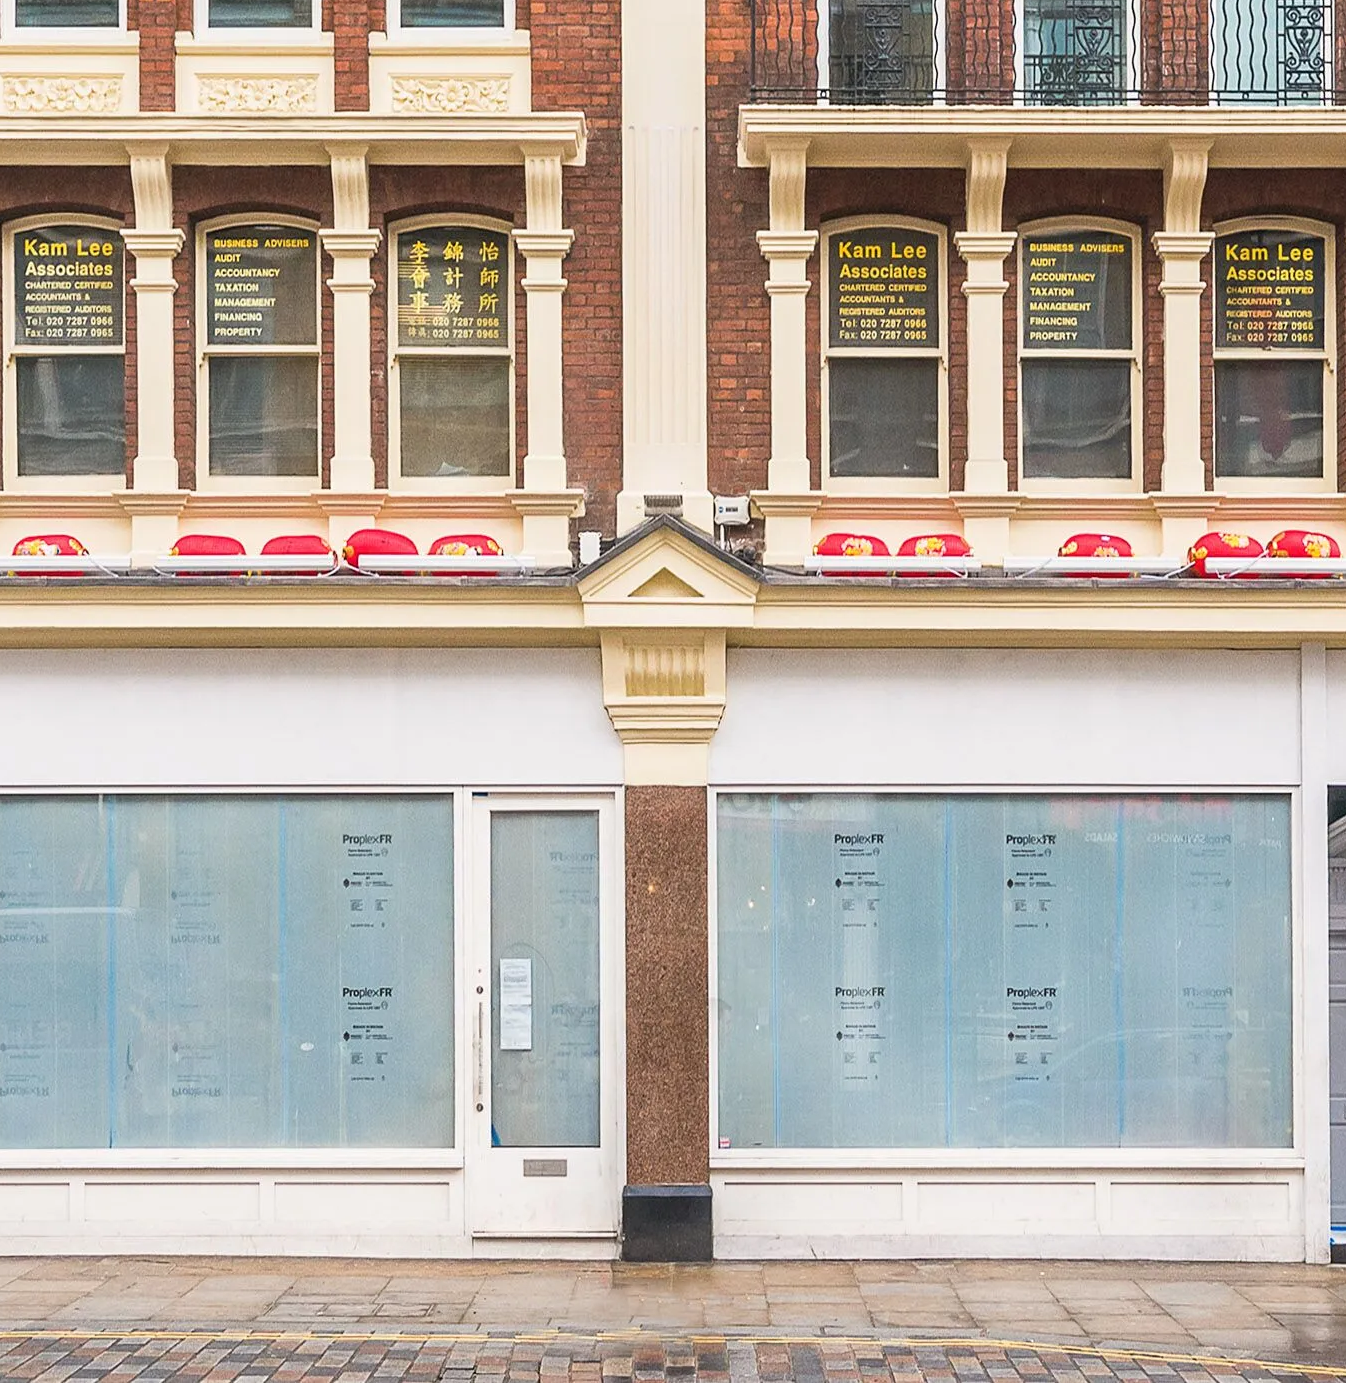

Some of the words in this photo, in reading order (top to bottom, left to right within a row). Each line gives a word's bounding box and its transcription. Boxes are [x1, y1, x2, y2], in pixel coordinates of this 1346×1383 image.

[25, 239, 67, 256] Kam
[77, 239, 113, 256] Lee
[839, 241, 881, 258] Kam
[891, 241, 927, 258] Lee
[1029, 244, 1073, 252] BUSINESS
[1079, 244, 1124, 252] ADVISERS
[1226, 243, 1268, 260] Kam
[1278, 243, 1314, 260] Lee
[214, 254, 241, 262] AUDIT
[1029, 258, 1056, 266] AUDIT
[25, 261, 113, 276] Associates
[214, 269, 280, 277] ACCOUNTANCY
[839, 263, 927, 278] Associates
[1226, 265, 1314, 280] Associates
[1029, 274, 1095, 282] ACCOUNTANCY
[214, 283, 258, 292] TAXATION
[1029, 288, 1073, 296] TAXATION
[214, 298, 276, 307] MANAGEMENT
[1029, 302, 1091, 312] MANAGEMENT
[214, 313, 262, 321] FINANCING
[1029, 318, 1077, 326] FINANCING
[214, 327, 262, 336] PROPERTY
[1029, 332, 1077, 340] PROPERTY
